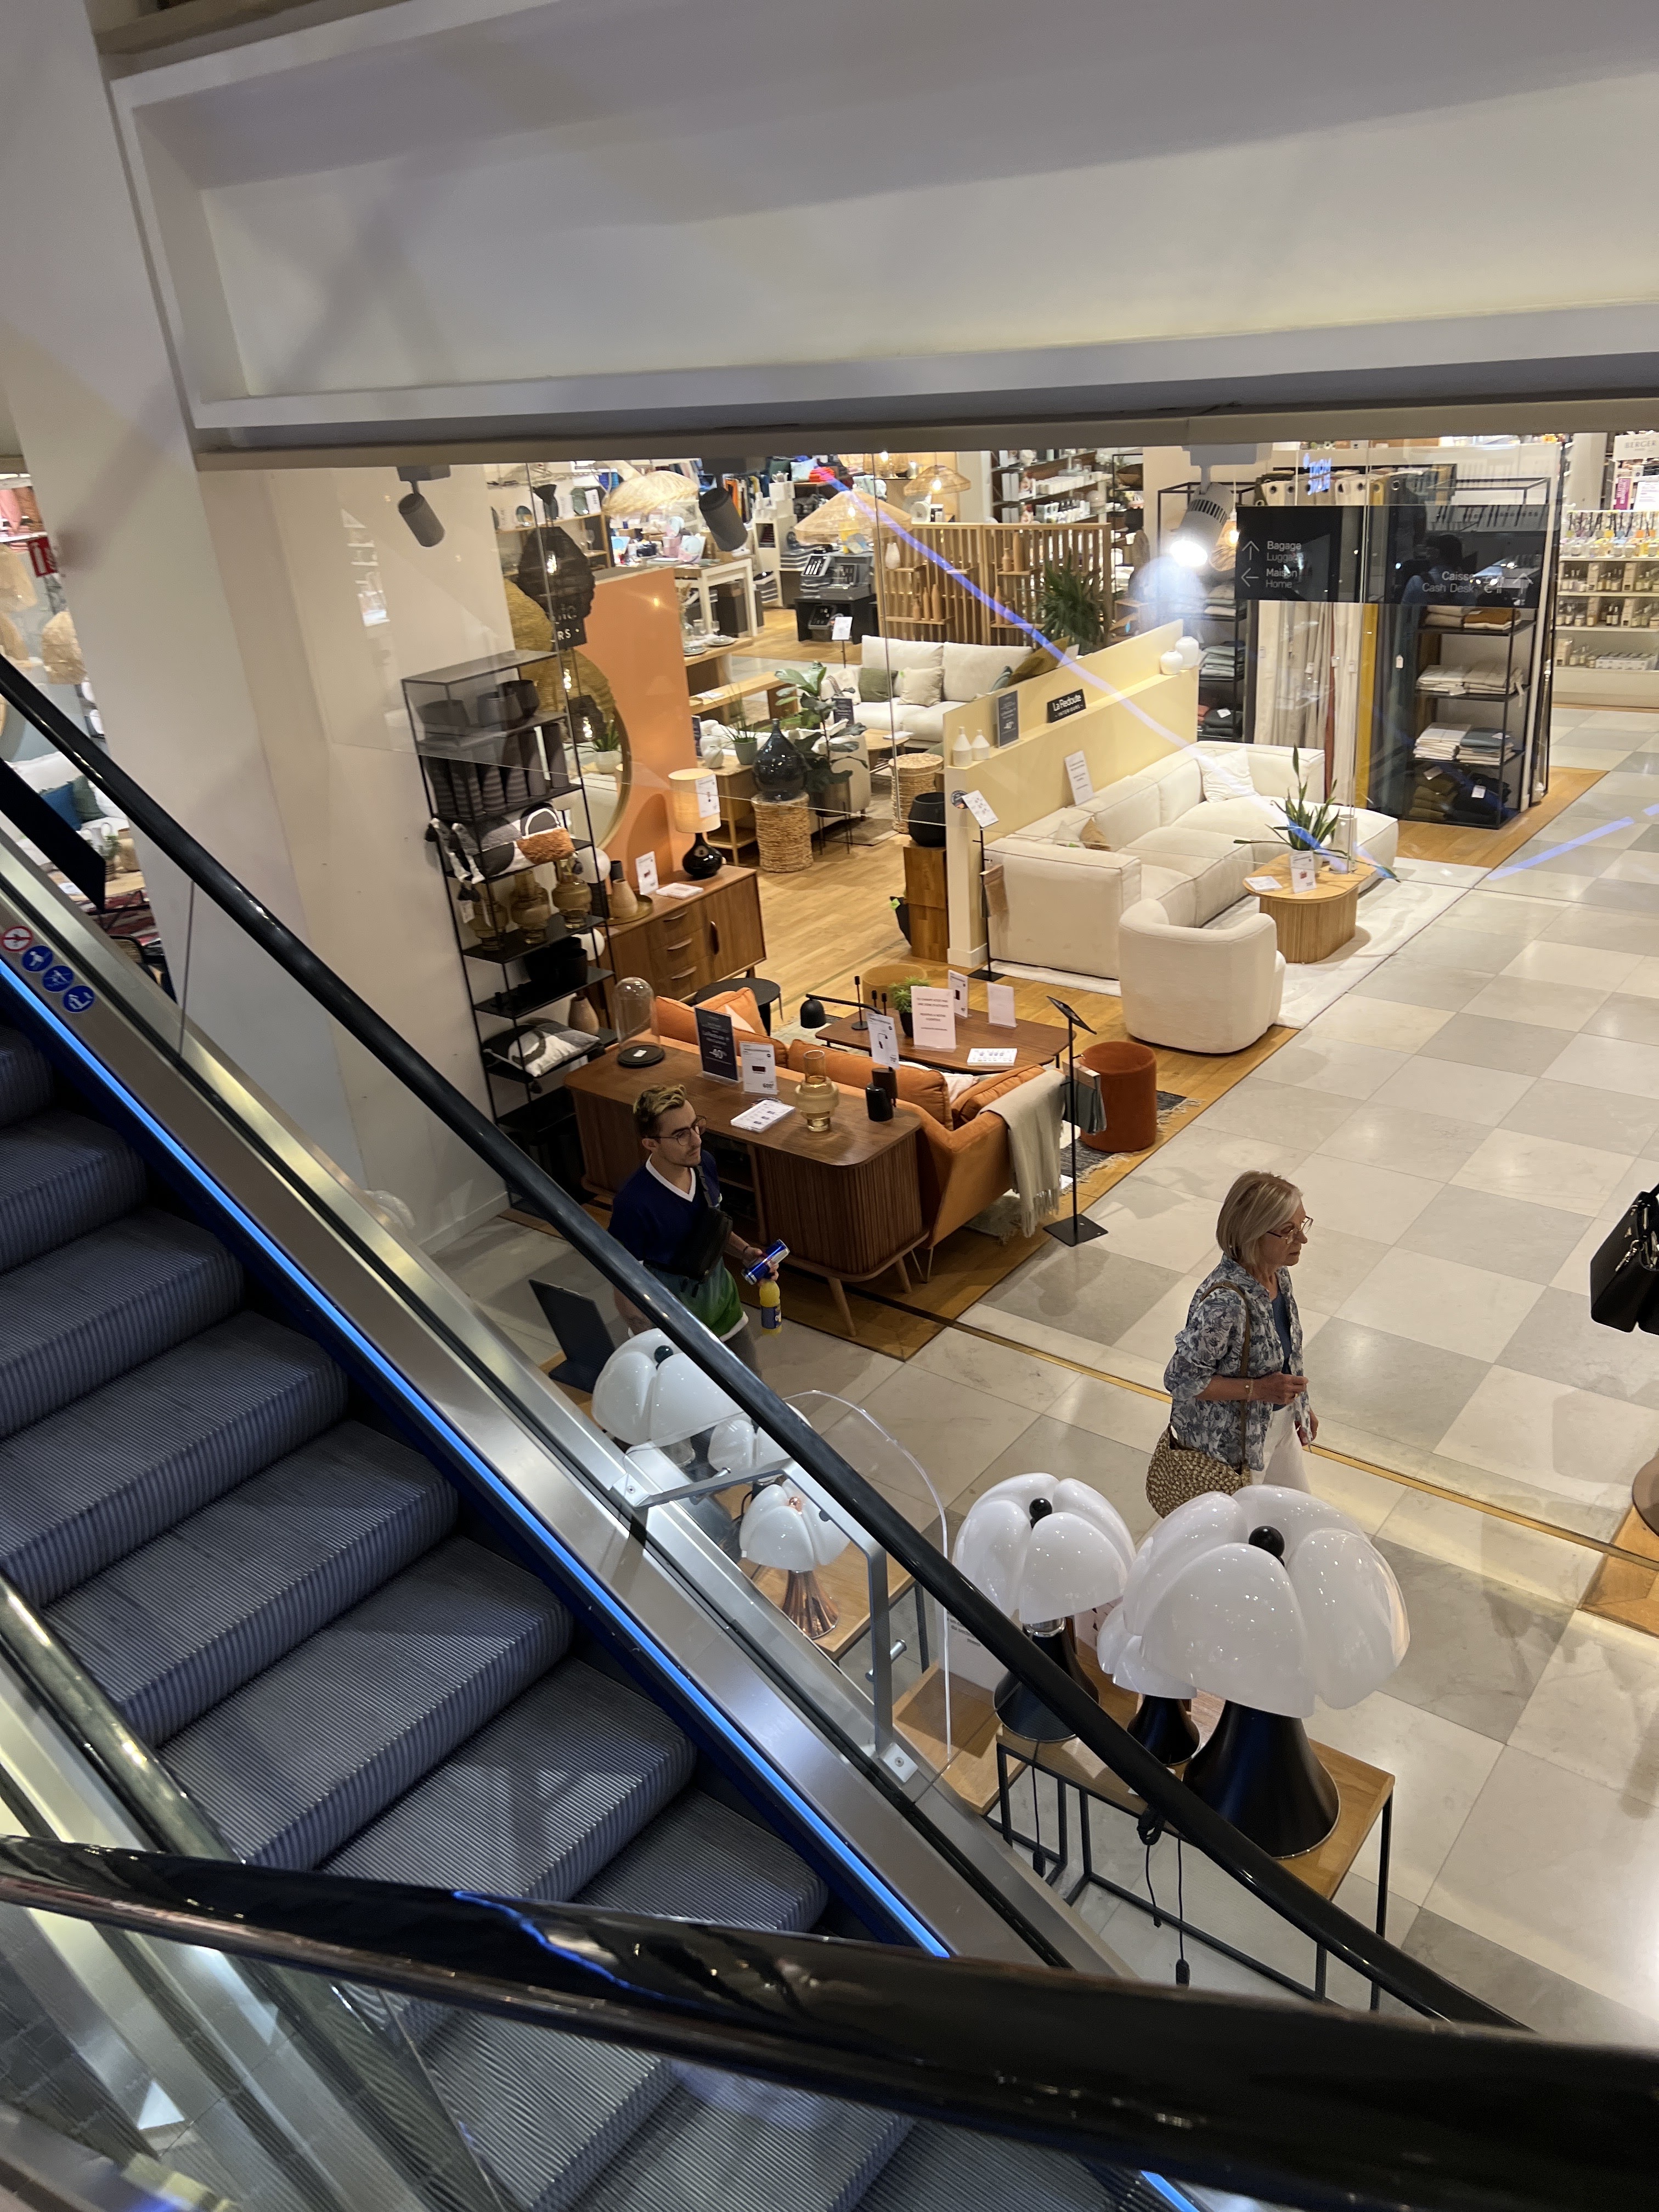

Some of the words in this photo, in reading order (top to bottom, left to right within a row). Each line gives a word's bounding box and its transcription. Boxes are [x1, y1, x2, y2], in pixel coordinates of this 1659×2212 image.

[1267, 540, 1301, 551] Bagage
[1266, 568, 1298, 579] Maison
[1441, 571, 1475, 580] Caisse
[1265, 579, 1293, 589] Home
[1422, 583, 1447, 592] Cash
[1450, 583, 1475, 592] Desk
[1052, 702, 1060, 711] La
